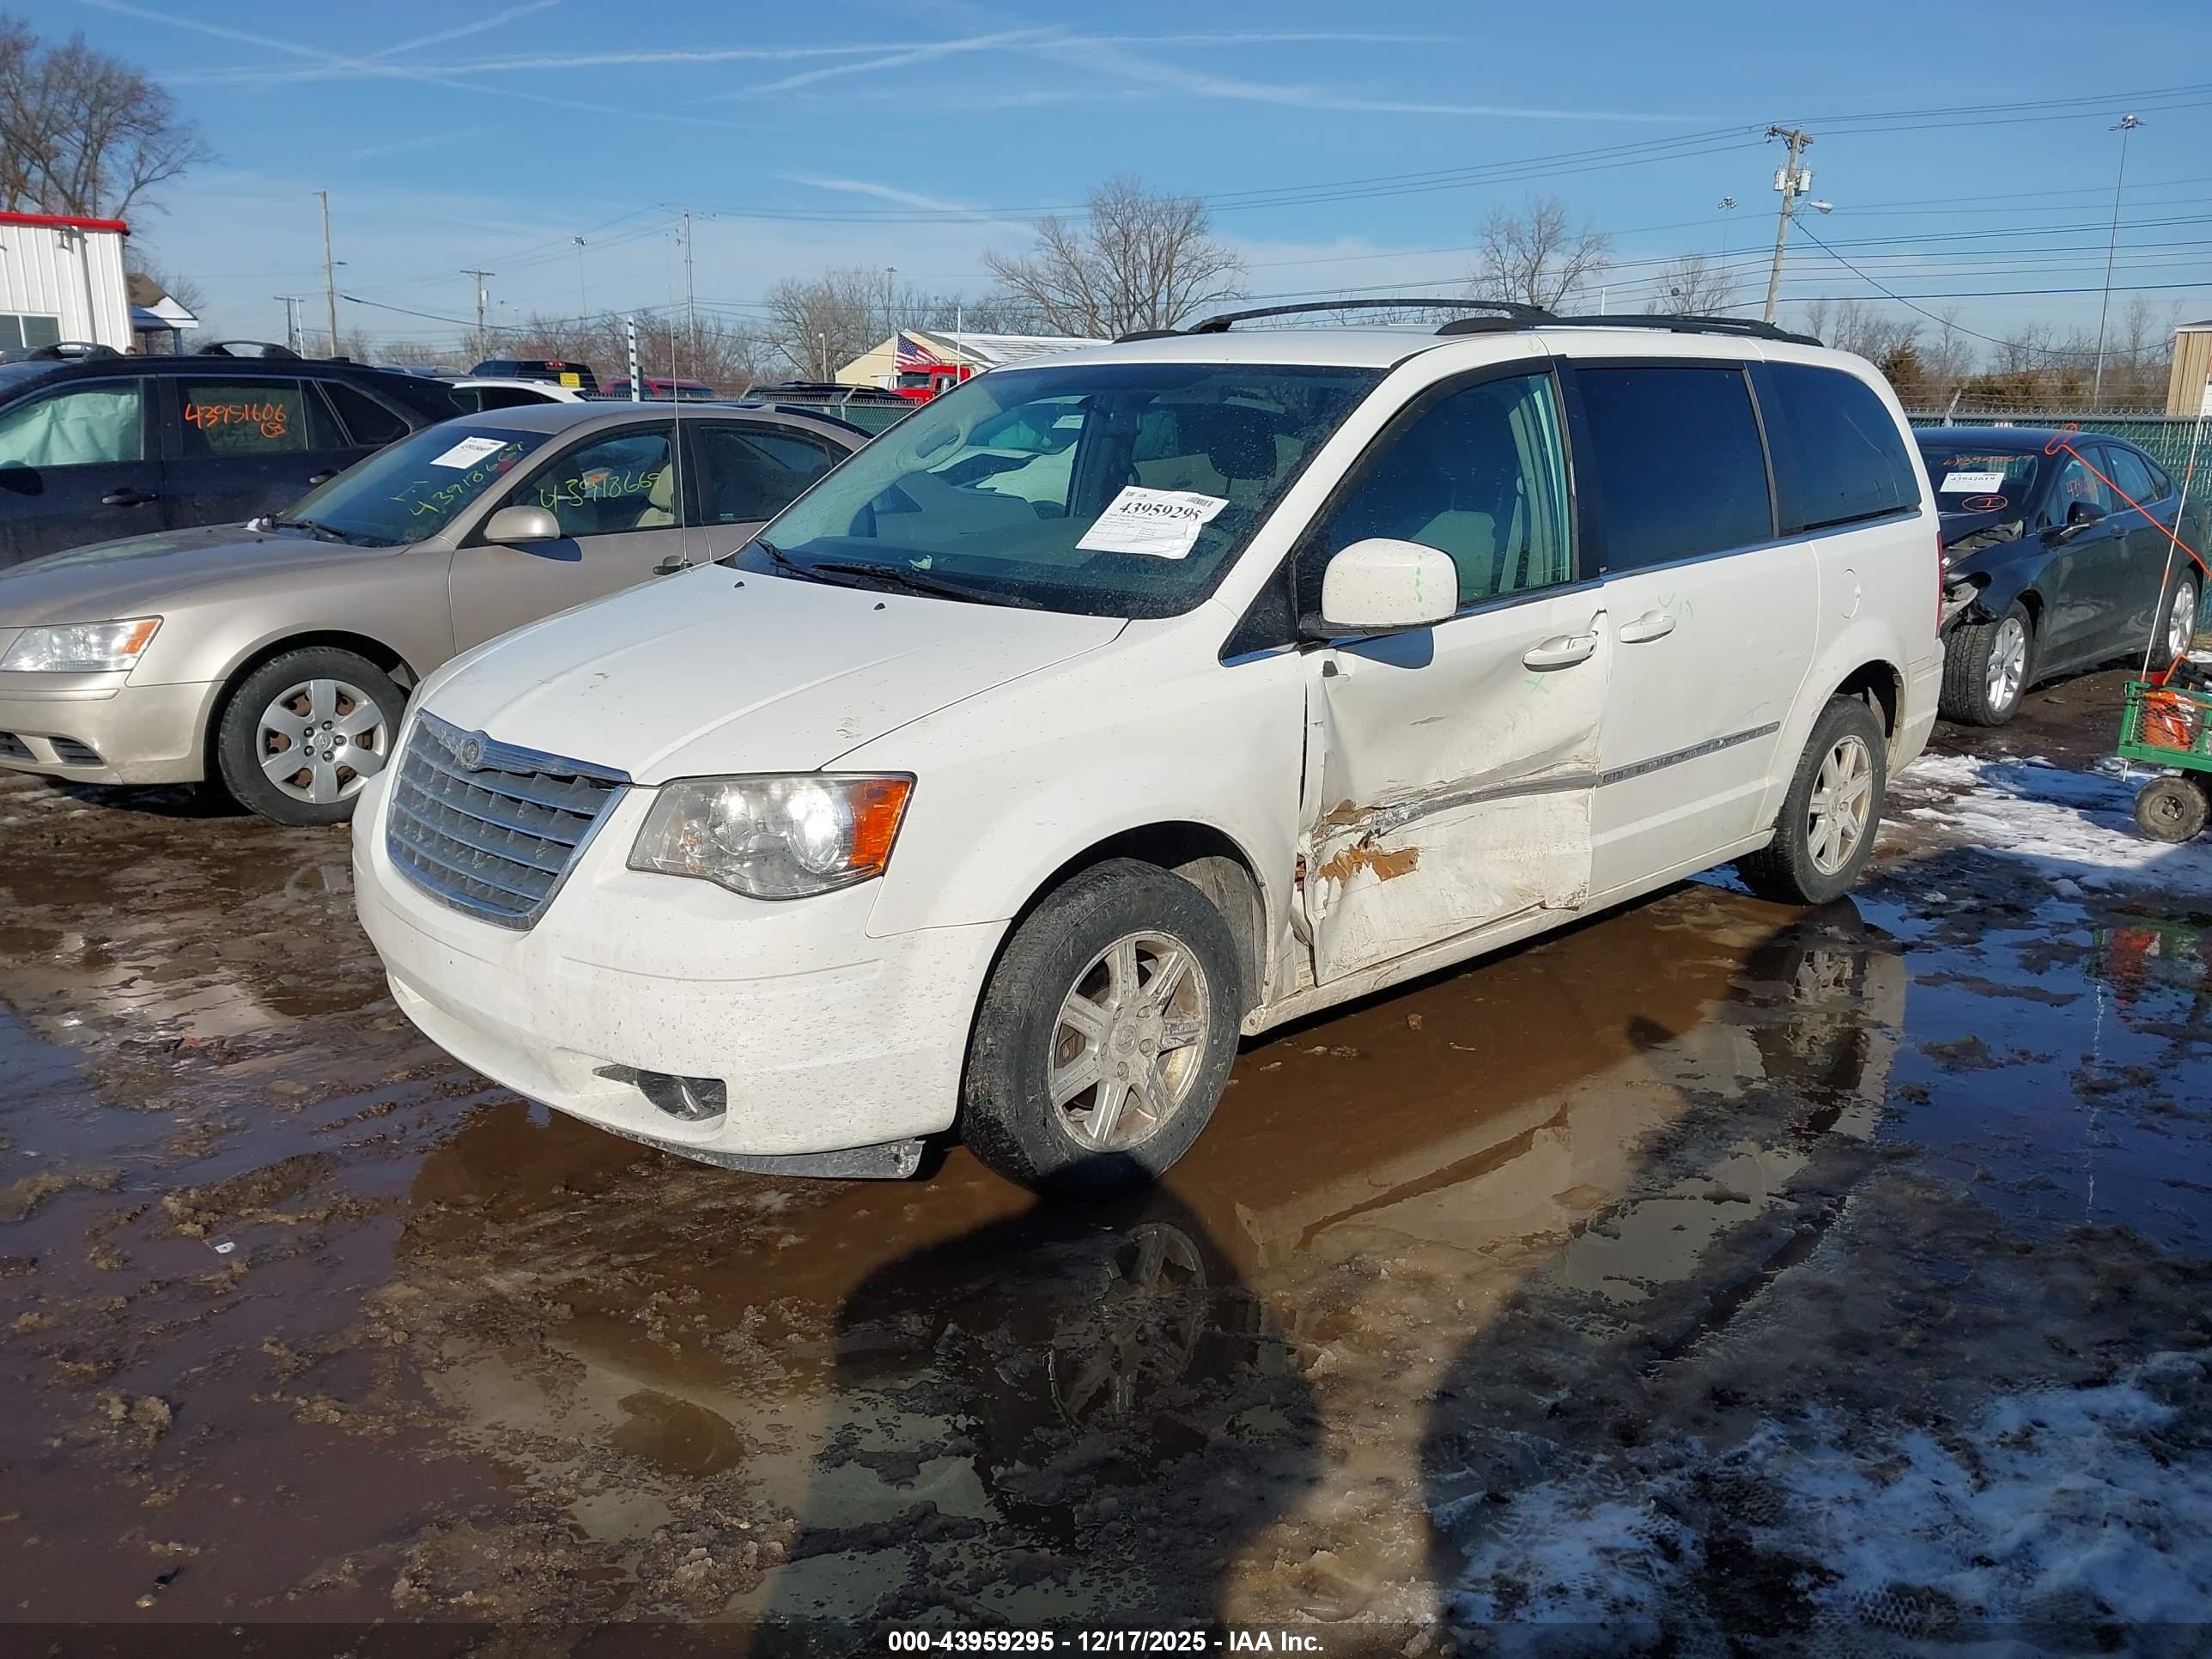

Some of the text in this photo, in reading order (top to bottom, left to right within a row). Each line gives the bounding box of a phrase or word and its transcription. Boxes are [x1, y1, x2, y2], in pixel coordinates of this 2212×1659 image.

[185, 403, 287, 429] 43951606
[540, 471, 660, 513] 43918669
[1119, 501, 1203, 521] 43959295
